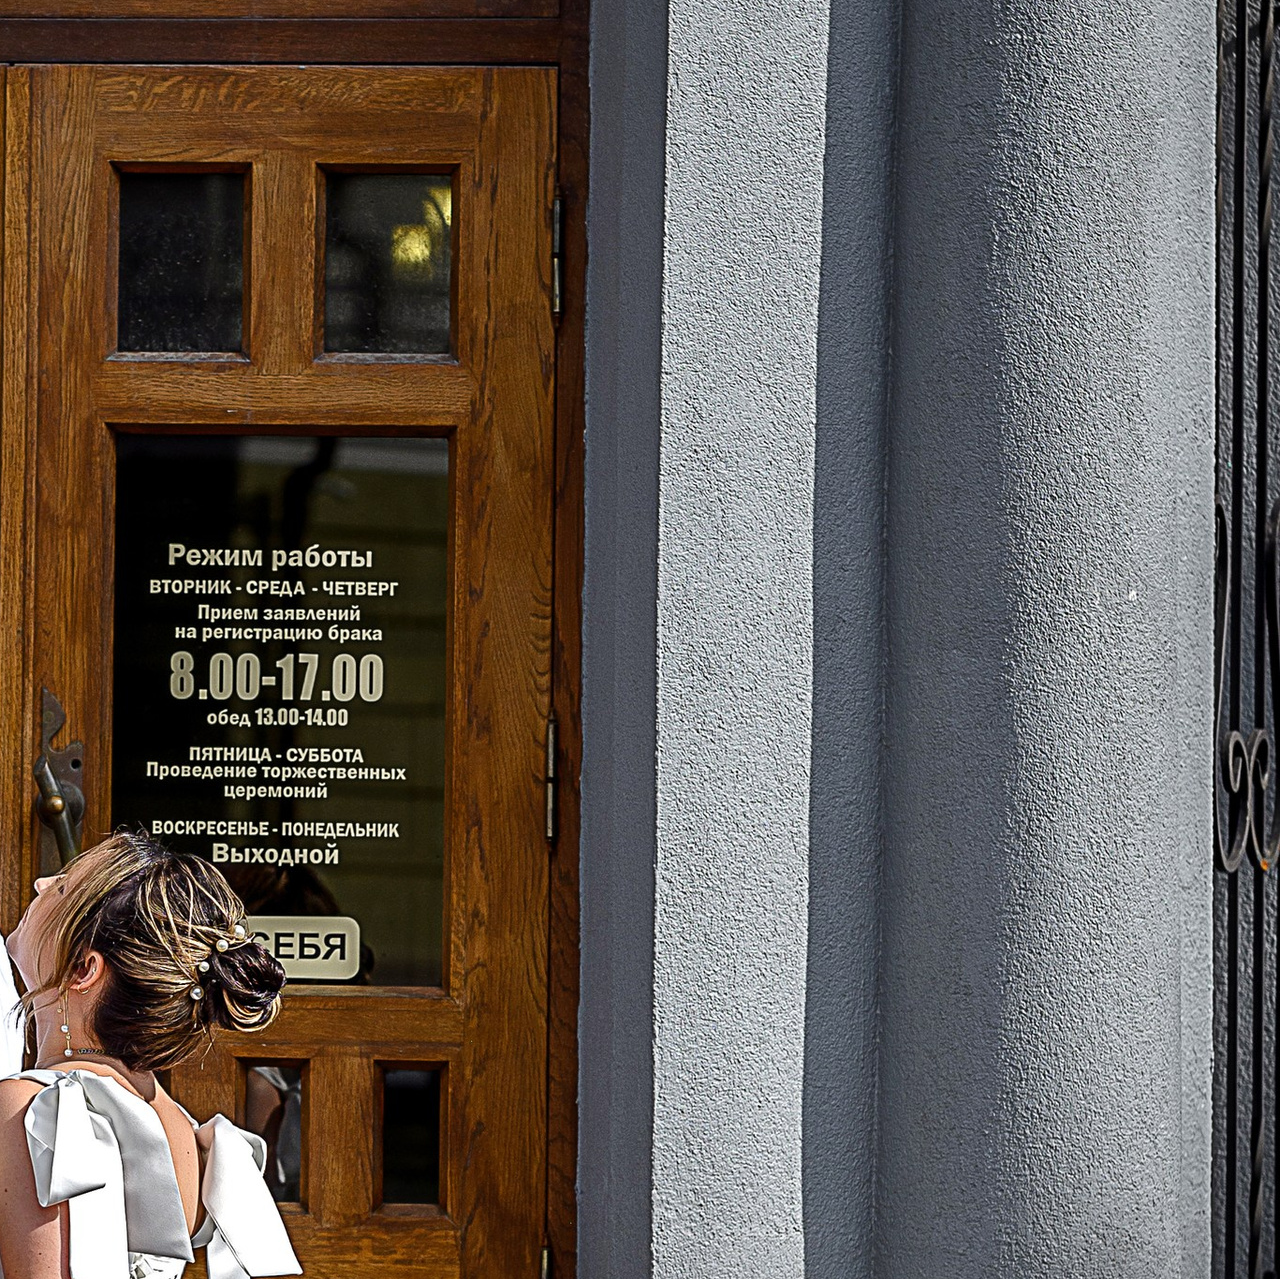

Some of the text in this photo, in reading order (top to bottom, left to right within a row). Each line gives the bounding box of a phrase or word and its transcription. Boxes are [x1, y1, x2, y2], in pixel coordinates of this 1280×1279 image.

[168, 543, 372, 571] Режим работы
[149, 579, 232, 595] ВТОРНИК
[245, 580, 306, 598] СРЕДА
[322, 581, 399, 597] ЧЕТВЕРГ
[197, 604, 361, 623] Прием заявлений
[175, 624, 383, 644] на регистрацию брака
[170, 651, 384, 702] 8.00-17.00
[206, 708, 349, 727] обед 13.00-14.00
[189, 746, 272, 764] ПЯТНИЦА
[286, 748, 364, 763] СУББОТА
[146, 761, 407, 782] Проведение торжественных
[224, 782, 328, 801] церемоний
[152, 820, 269, 836] ВОСКРЕСЕНЬЕ
[281, 822, 400, 839] ПОНЕДЕЛЬНИК
[212, 842, 339, 867] Выходной
